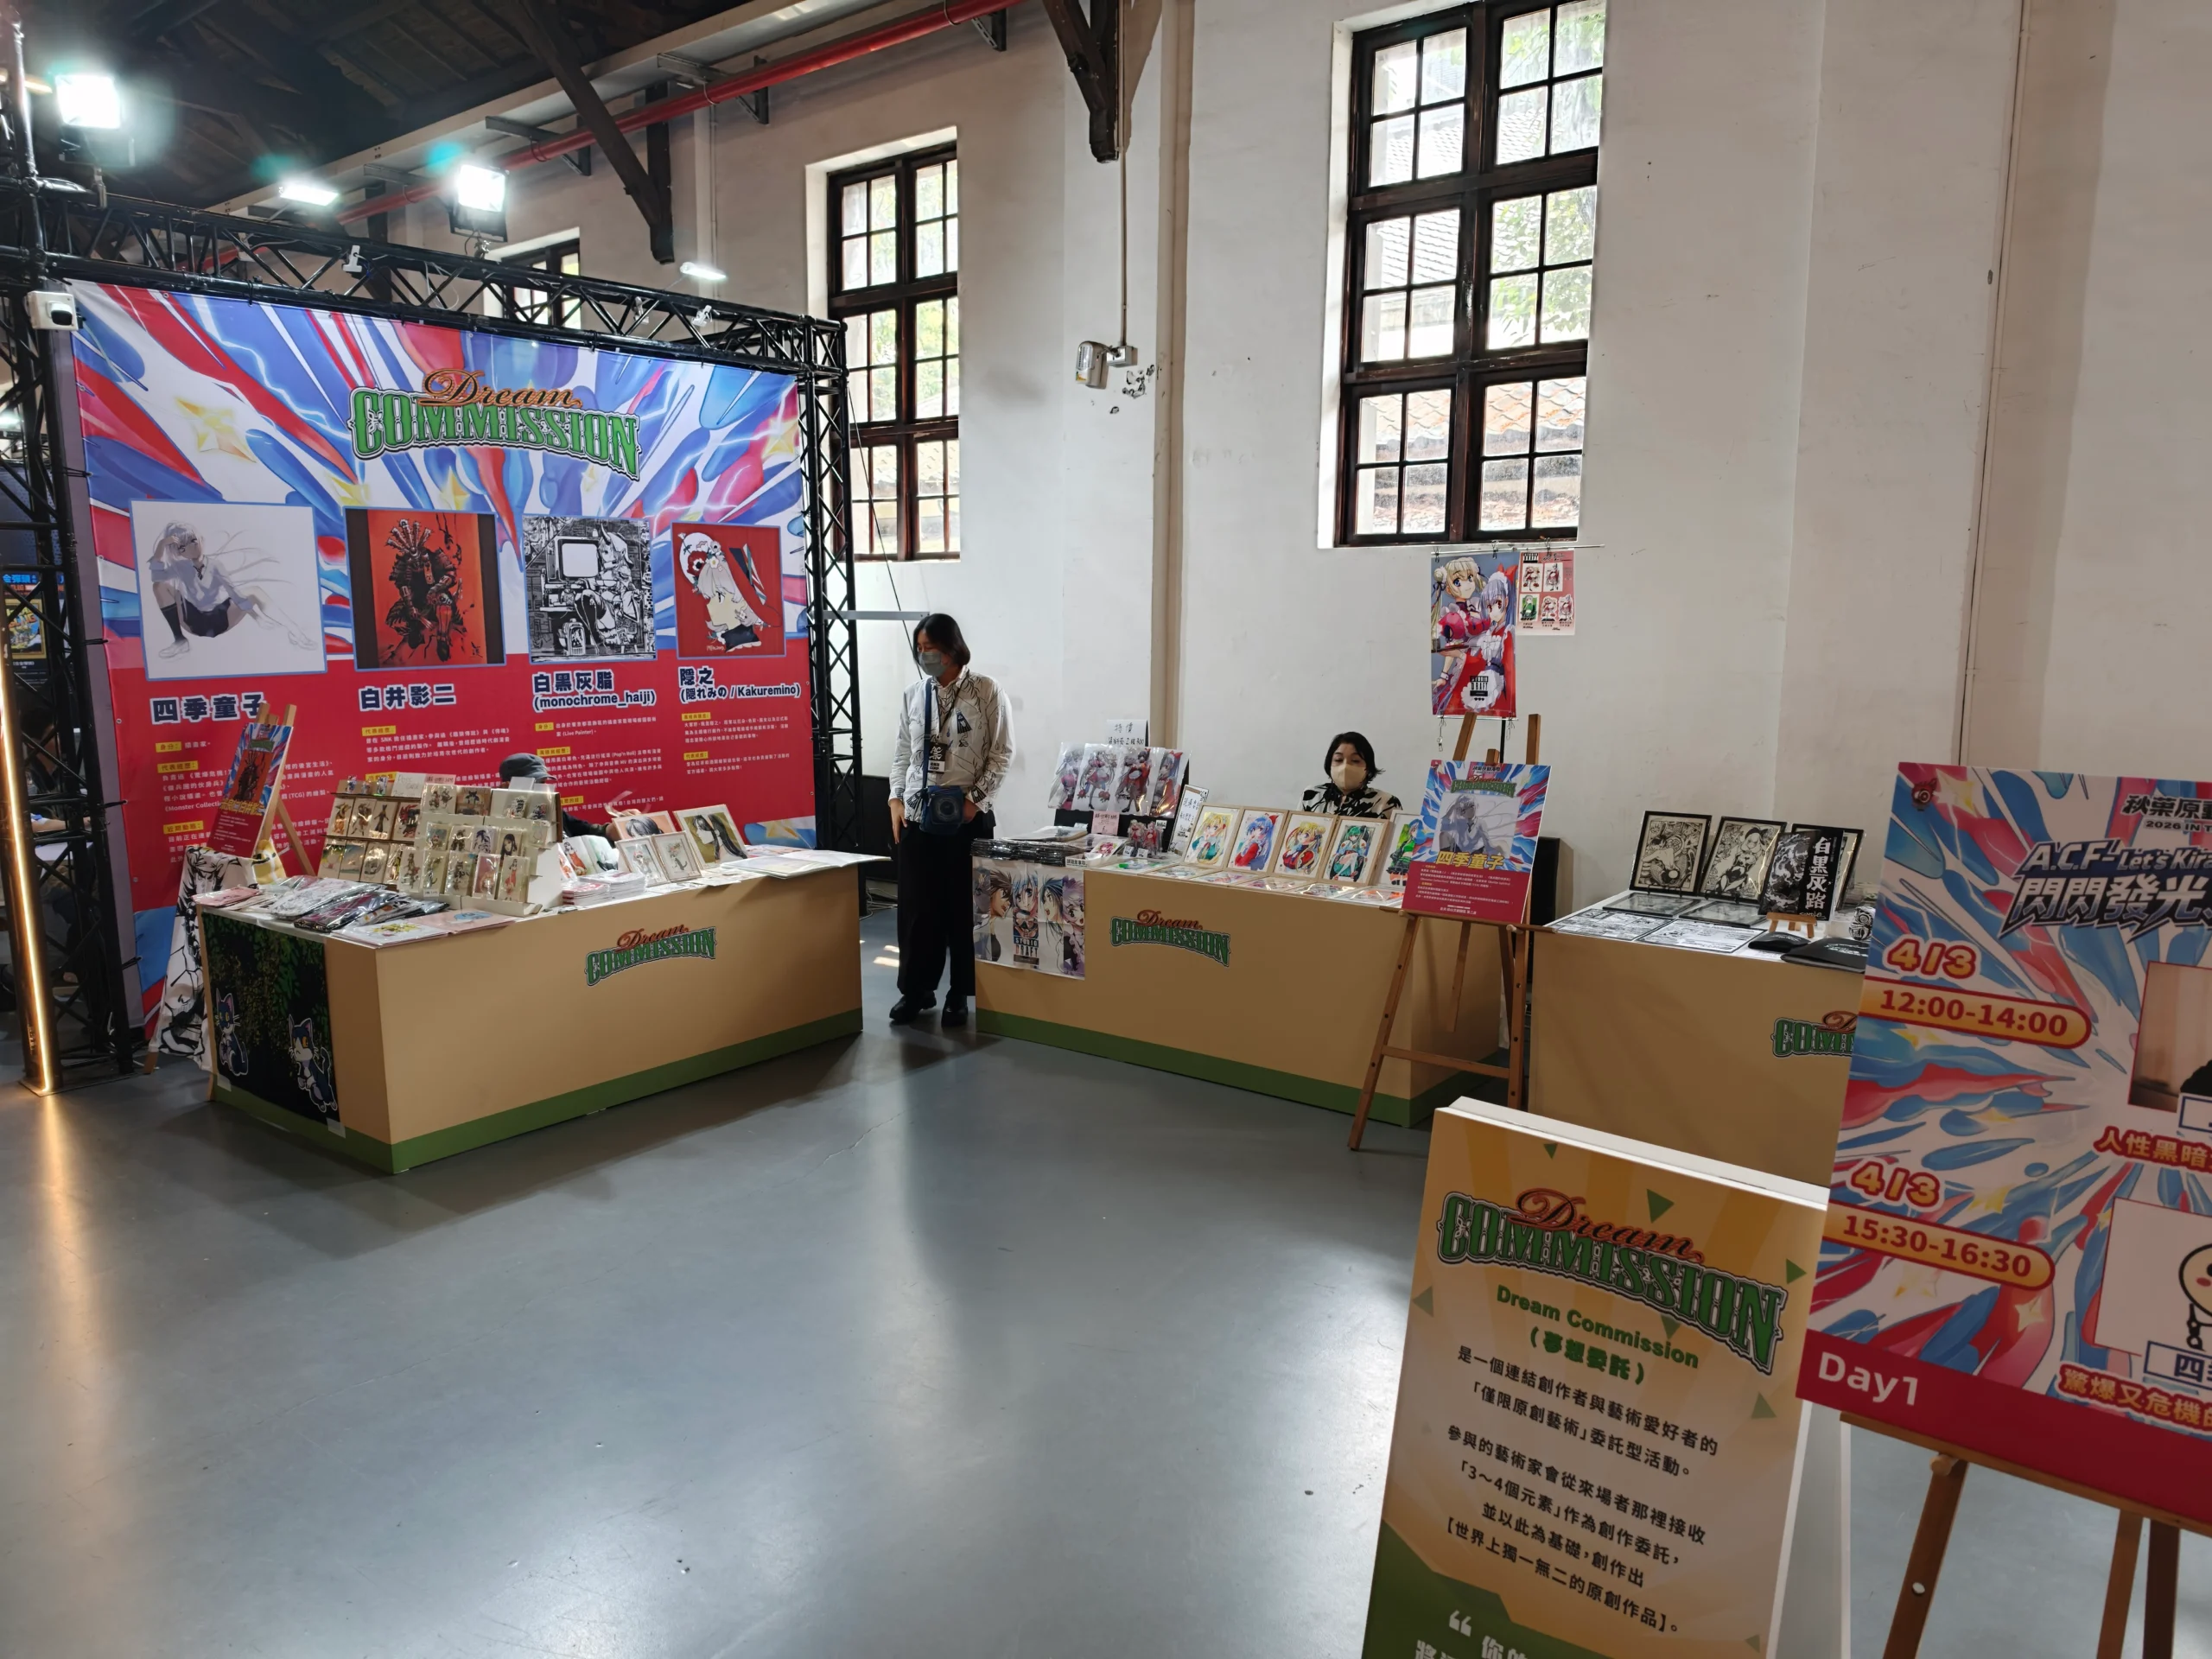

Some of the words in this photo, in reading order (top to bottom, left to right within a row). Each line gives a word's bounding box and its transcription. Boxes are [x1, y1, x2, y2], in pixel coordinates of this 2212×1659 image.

[417, 368, 583, 408] Dream
[347, 386, 641, 481] COMMISSION
[359, 682, 456, 711] 白井影二
[532, 671, 613, 695] 白黑灰脂
[533, 690, 657, 712] (monochrome_haiji)
[679, 667, 714, 686] 隱之
[737, 683, 800, 696] Kakuremino)
[150, 693, 264, 725] 四季童子
[2145, 820, 2181, 830] 2026
[2185, 823, 2201, 832] IN
[1435, 850, 1505, 871] 四季童子
[1135, 909, 1204, 930] Dream
[2009, 873, 2212, 930] 閃閃發光
[584, 926, 718, 986] COMMISSION
[614, 924, 690, 952] Dream
[1109, 916, 1231, 967] COMMISSION
[1887, 938, 1978, 980] 4/3
[1879, 989, 2069, 1038] 12:00-14:00
[2095, 1127, 2212, 1172] 人性黑暗
[1851, 1160, 1941, 1209] 4/3
[1506, 1187, 1705, 1264] Dream
[1842, 1214, 2032, 1278] 15:30-16:30
[1437, 1192, 1789, 1375] COMMISSION
[1497, 1284, 1560, 1321] Dream
[1567, 1304, 1700, 1369] Commission
[1458, 1344, 1719, 1457] 是一個連結創作者與藝術愛好者的
[1818, 1351, 1918, 1407] Day1
[1473, 1381, 1690, 1478] 「僅限原創藝術」委託型活動。
[1447, 1424, 1707, 1546] 參與的藝術家會從來場者那裡接收
[1481, 1502, 1645, 1588] 並以此為基礎，創作出
[1446, 1516, 1678, 1633] 【世界上獨一無二的原創作品】。
